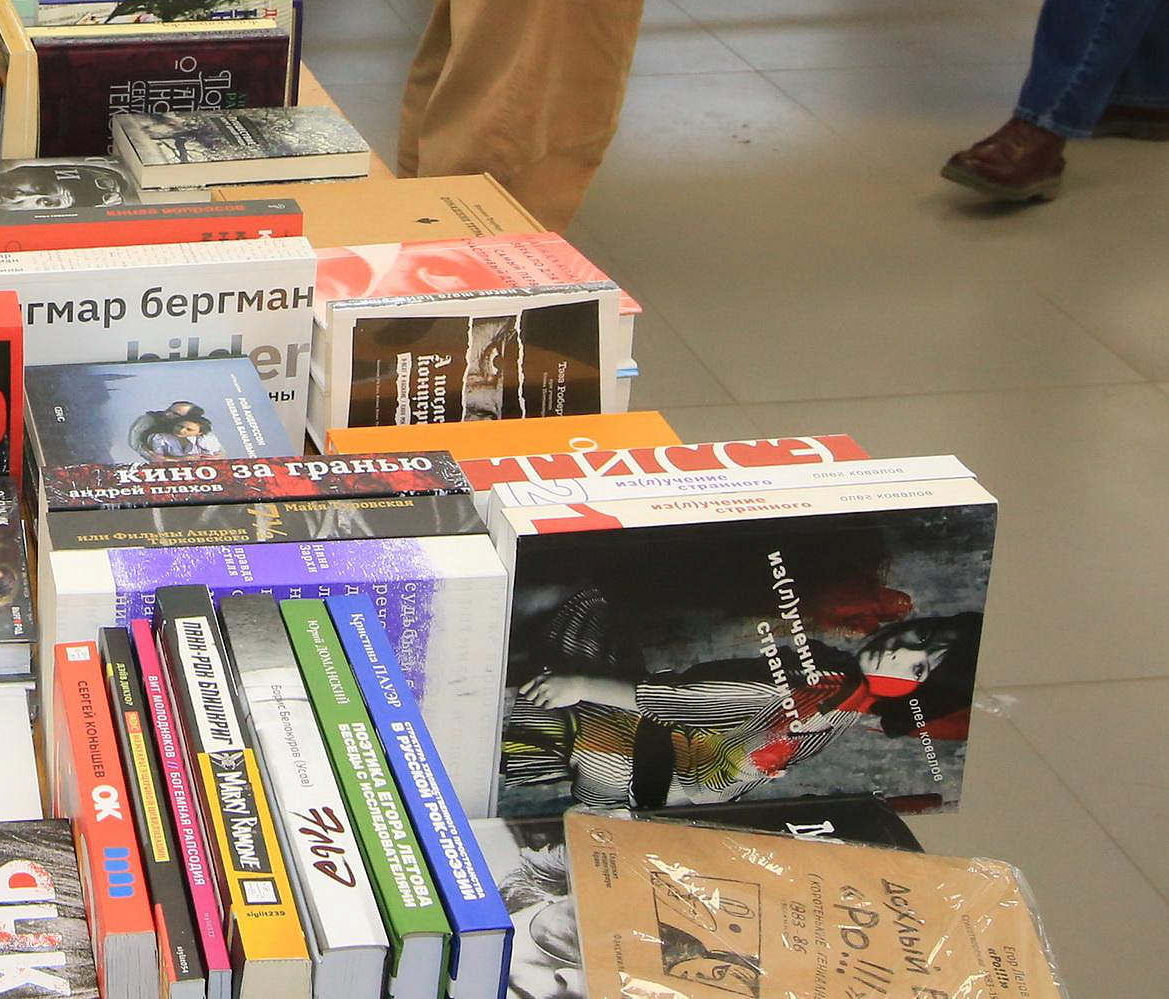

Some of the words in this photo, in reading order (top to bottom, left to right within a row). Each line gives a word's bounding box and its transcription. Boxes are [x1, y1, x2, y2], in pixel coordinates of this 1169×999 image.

[140, 286, 314, 324] бергман
[69, 485, 147, 500] андрей
[150, 483, 224, 497] плахов
[116, 463, 218, 485] кино
[231, 459, 275, 480] за
[282, 454, 433, 481] гранью
[678, 478, 773, 492] странного
[849, 467, 905, 477] ковалов
[284, 501, 326, 512] Майя
[714, 501, 812, 515] странного
[876, 490, 934, 500] ковалов
[77, 533, 104, 543] или
[107, 531, 181, 543] Фильмы
[184, 528, 247, 540] Андрея
[148, 534, 250, 547] Тарковского
[299, 545, 318, 574] Зархи
[312, 544, 330, 570] Нина
[234, 547, 254, 582] правда
[767, 550, 822, 687] из(л)учение
[147, 674, 159, 693] ВИТ
[306, 619, 323, 644] Юрий
[315, 643, 351, 705] ДОМАНСКИЙ
[349, 612, 378, 662] Кристина
[368, 661, 403, 709] ПАУЭР
[756, 620, 805, 734] странного
[77, 680, 92, 719] СЕРГЕЙ
[85, 721, 106, 778] КОНЫШЕВ
[151, 694, 176, 758] МОЛОДНЯКОВ
[278, 713, 302, 762] Белокуров
[293, 762, 315, 788] (Усов)
[390, 721, 403, 733] В
[909, 697, 926, 729] олег
[919, 731, 943, 783] ковалов
[216, 770, 248, 816] MARKY
[395, 734, 431, 800] РУССКОЙ
[169, 771, 192, 829] БОГЕМНАЯ
[337, 722, 365, 773] БЕСЕДЫ
[360, 782, 417, 908] ИССЛЕДОВАТЕЛЯМИ
[351, 722, 387, 789] ПОЭТИКА
[376, 790, 406, 840] ЕГОРА
[394, 841, 434, 908] ЛЕТОВА
[180, 830, 206, 887] РАПСОДИЯ
[230, 817, 262, 871] RAMONE
[424, 801, 479, 901] РОК-ПОЭЗИИ
